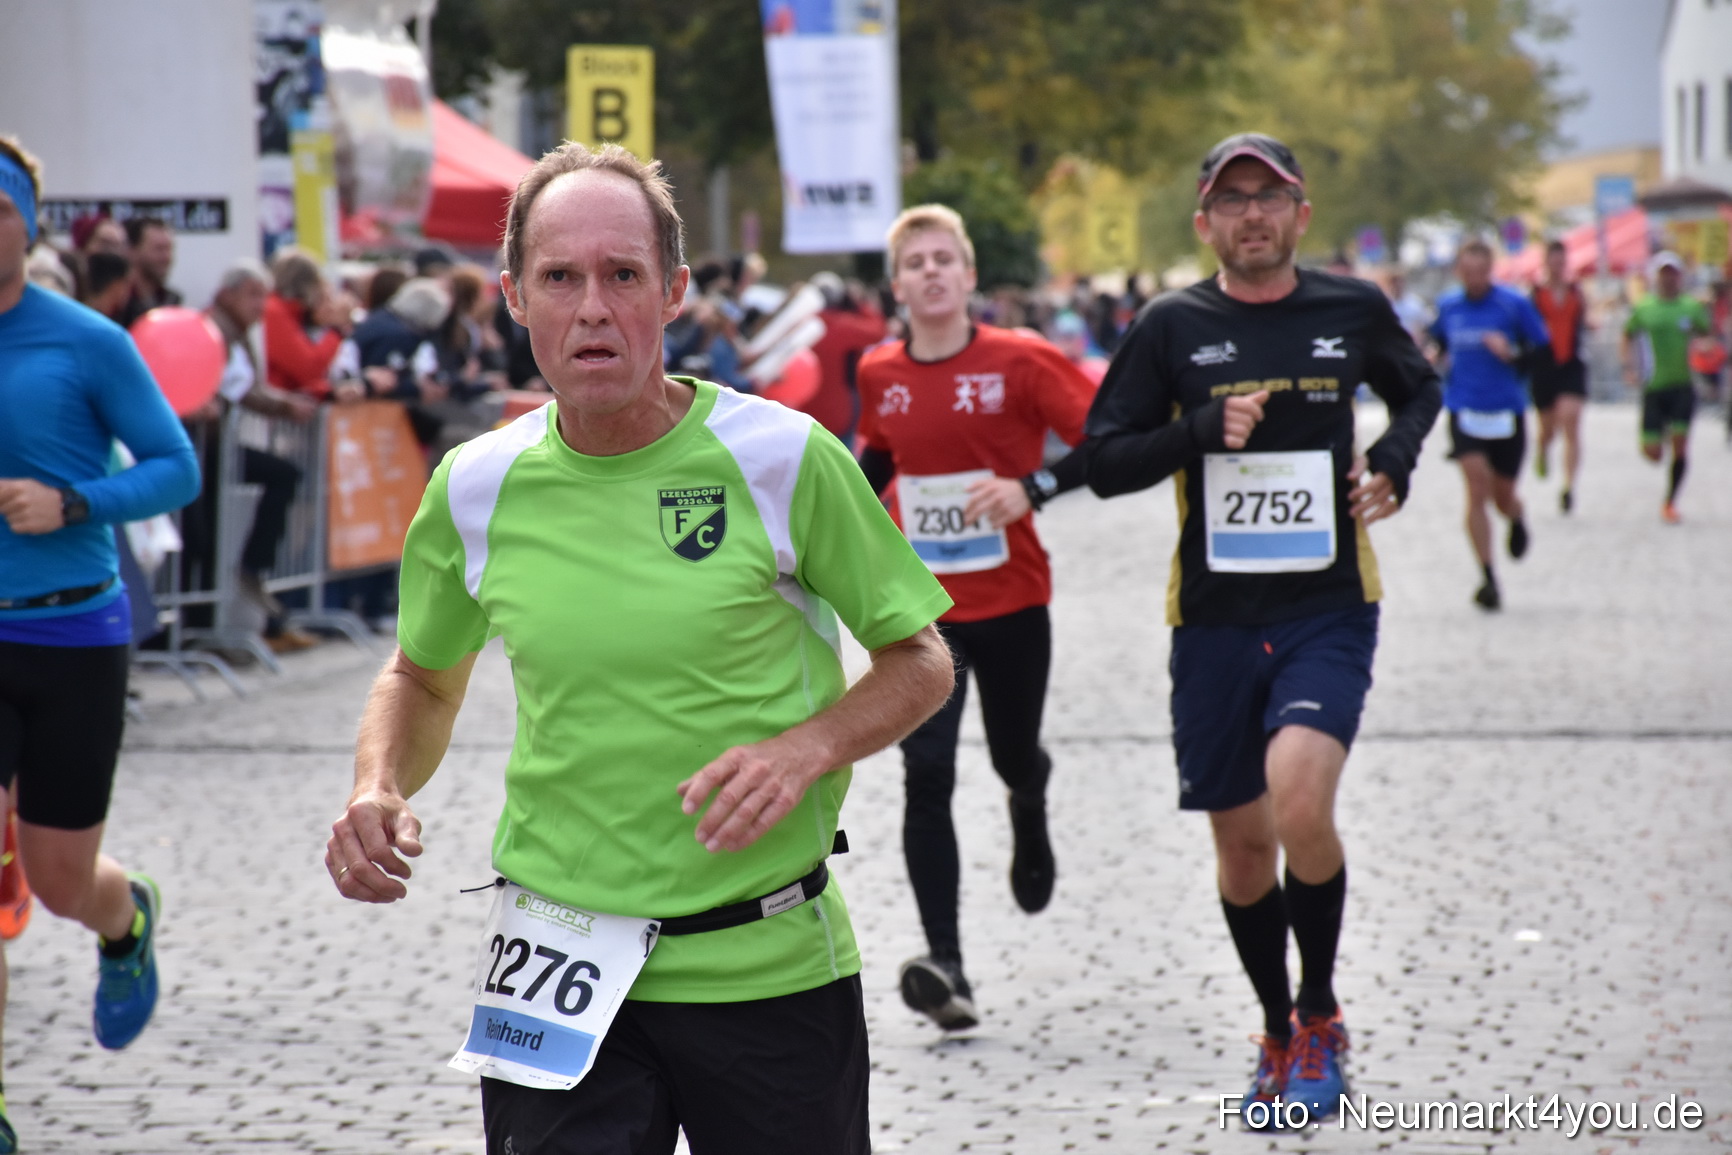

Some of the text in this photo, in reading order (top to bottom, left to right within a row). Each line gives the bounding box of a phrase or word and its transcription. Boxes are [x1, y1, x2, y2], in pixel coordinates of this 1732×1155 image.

[591, 87, 630, 142] B
[661, 488, 723, 498] EZELSDORF
[1224, 489, 1314, 525] 2752
[675, 509, 690, 534] F
[697, 525, 716, 549] C
[528, 896, 596, 932] BOCK
[484, 933, 602, 1017] 2276
[484, 1017, 545, 1052] Reinhard
